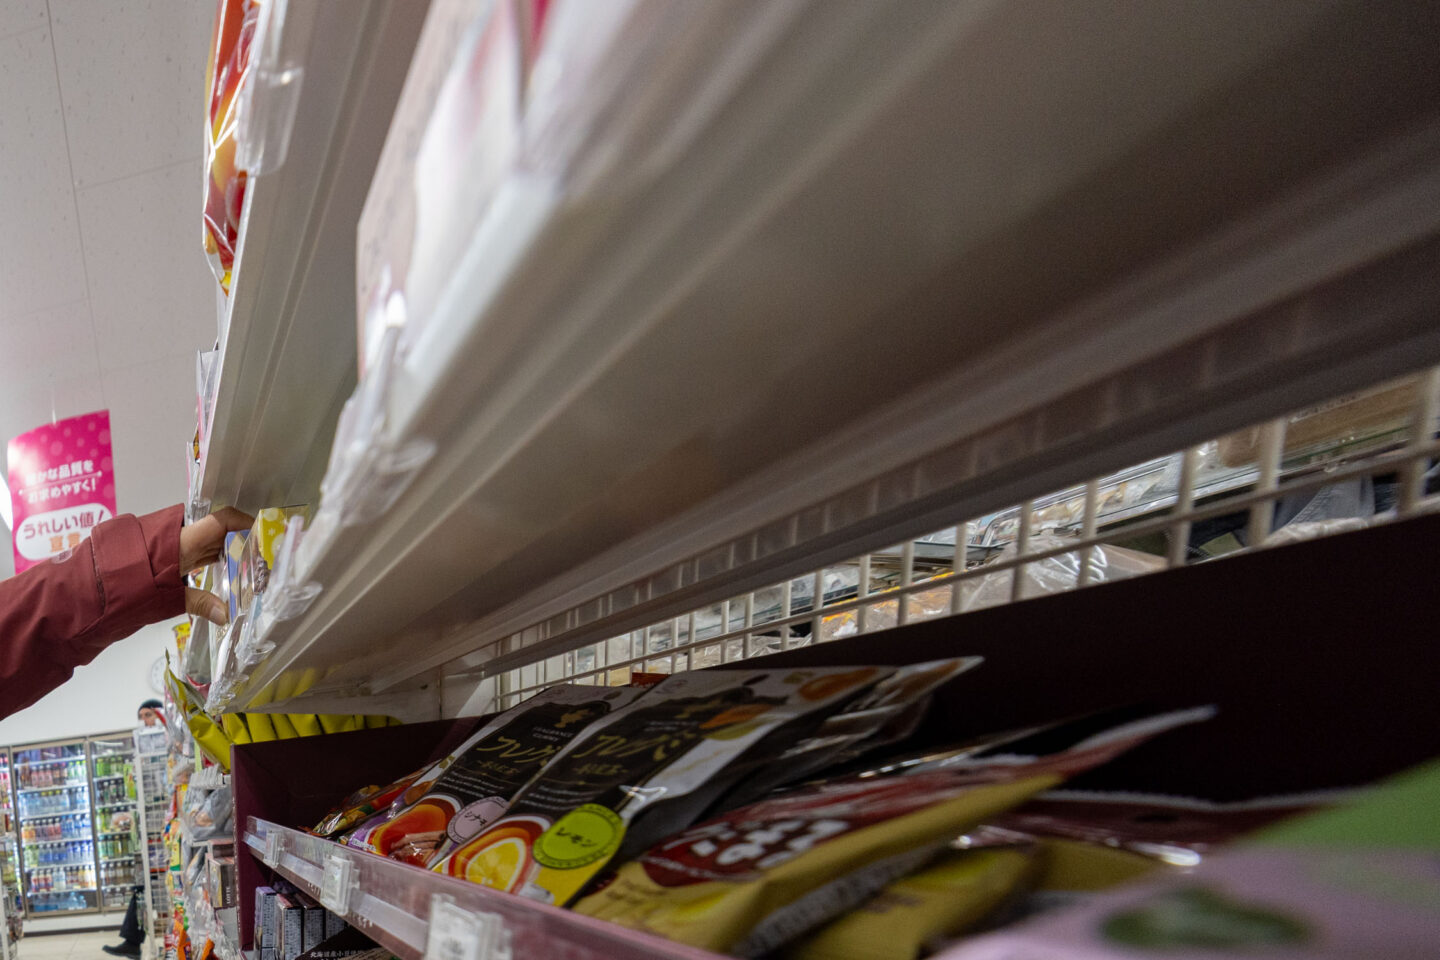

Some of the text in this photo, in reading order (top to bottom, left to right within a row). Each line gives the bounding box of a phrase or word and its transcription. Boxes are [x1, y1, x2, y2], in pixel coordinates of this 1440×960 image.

[24, 509, 104, 539] うれしい値!
[553, 826, 600, 848] レモン
